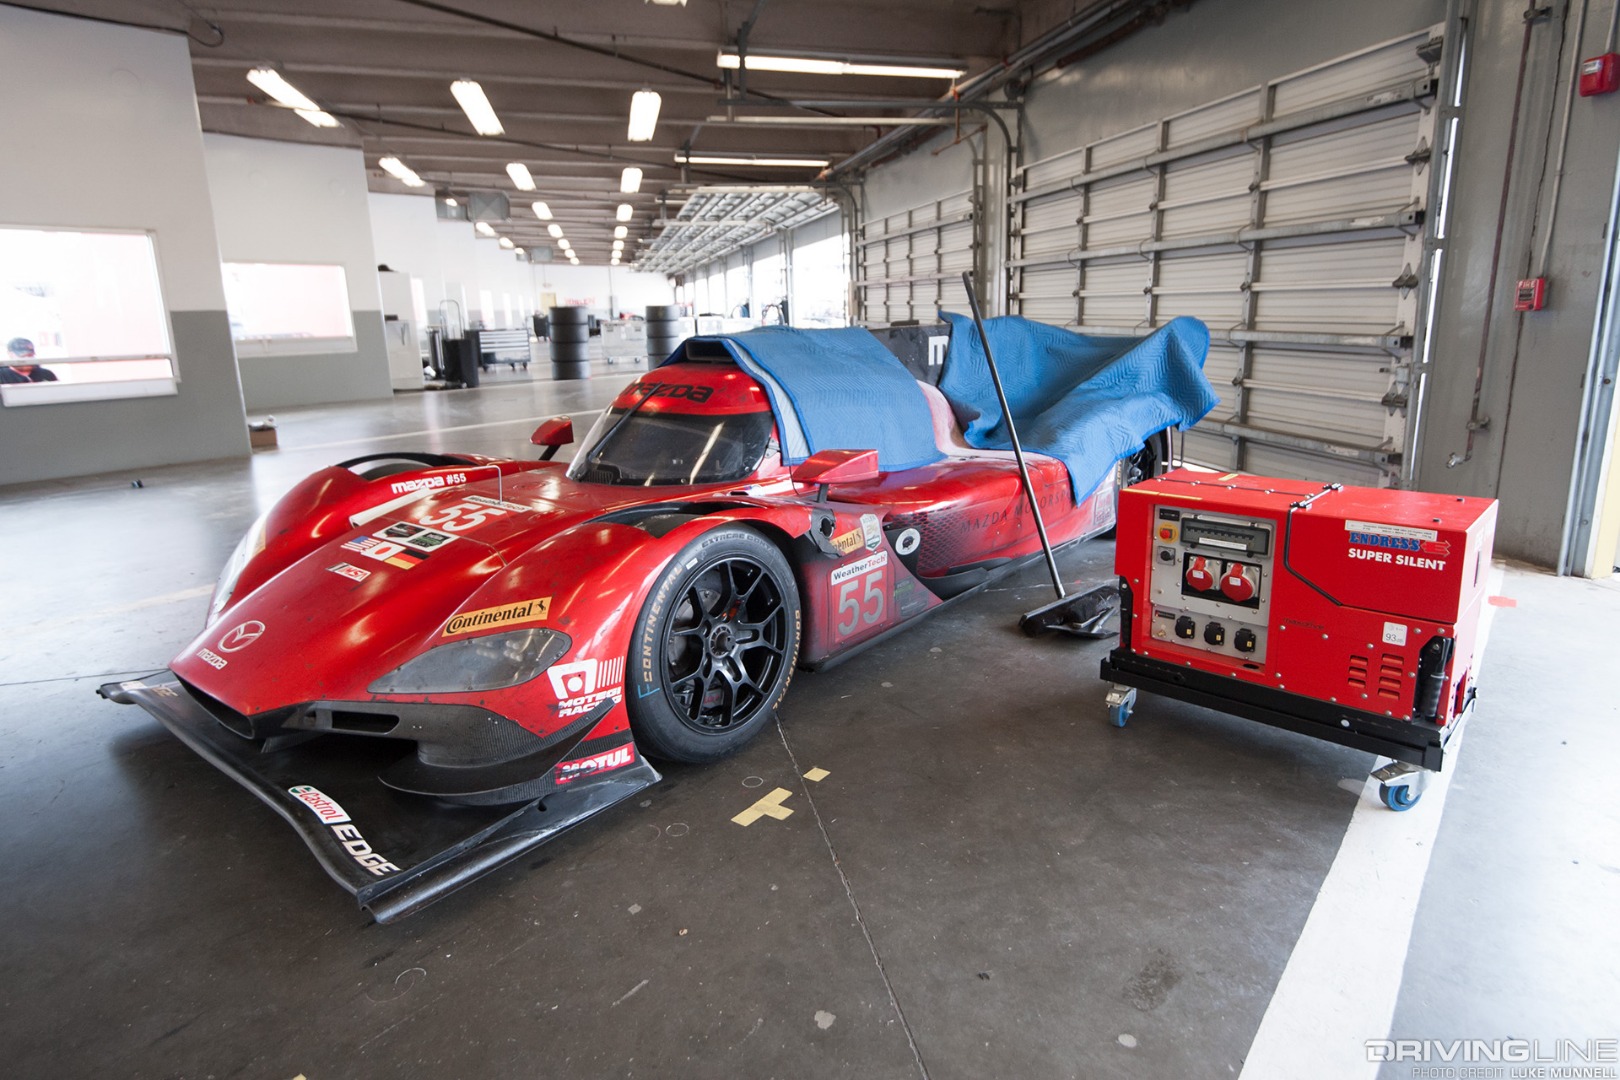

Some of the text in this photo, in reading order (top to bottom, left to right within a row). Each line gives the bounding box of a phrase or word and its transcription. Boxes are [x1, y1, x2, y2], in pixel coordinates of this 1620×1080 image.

[446, 473, 467, 485] #55
[419, 502, 507, 532] 55
[960, 510, 1008, 534] MAZDA
[1350, 532, 1421, 552] ENDRESS
[833, 555, 886, 580] WeatherTech
[1348, 548, 1446, 571] SUPER SILENT
[838, 570, 884, 636] 55
[446, 602, 534, 634] Continental
[642, 565, 684, 682] CONTINENTAL
[558, 686, 622, 709] MOTEGI
[299, 790, 401, 876] Castrol EDGE
